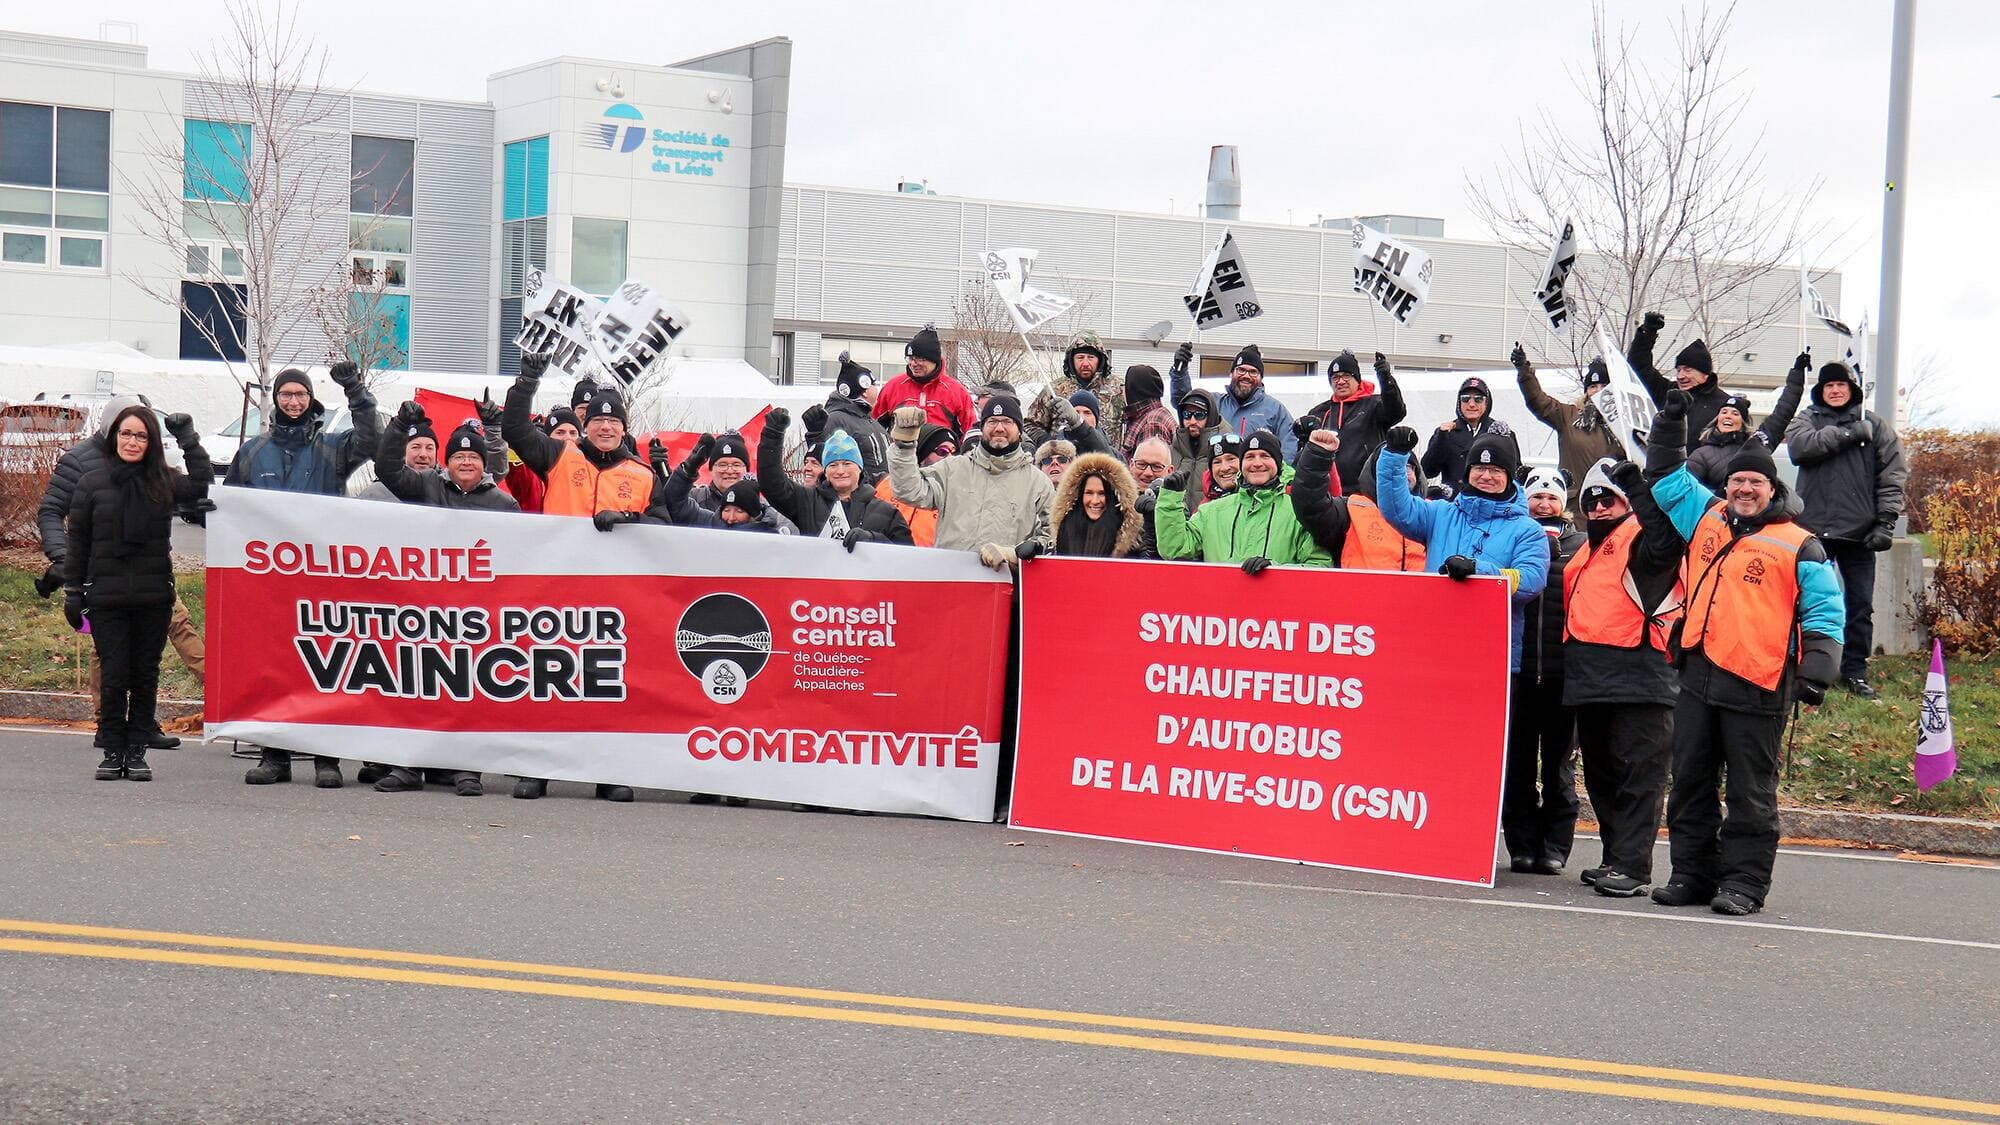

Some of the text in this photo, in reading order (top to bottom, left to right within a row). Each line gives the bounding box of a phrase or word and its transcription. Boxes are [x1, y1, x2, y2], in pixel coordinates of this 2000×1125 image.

[652, 128, 730, 148] Société de
[652, 145, 724, 162] transport
[652, 160, 713, 176] de Lévis
[1372, 241, 1410, 277] EN
[991, 272, 1011, 280] CSN
[1213, 259, 1246, 292] EN
[526, 289, 538, 299] SN
[544, 289, 585, 329] EN
[611, 308, 689, 386] RÈVE
[244, 539, 493, 581] SOLIDARITÉ
[1743, 575, 1762, 585] CSN
[300, 602, 624, 641] LUTTONS POUR
[790, 600, 897, 625] Conseil
[792, 625, 896, 647] central
[1139, 613, 1376, 657] SYNDICAT DES
[299, 639, 625, 700] VAINCRE
[793, 652, 811, 663] de
[793, 664, 865, 677] Chaudière-
[713, 686, 737, 696] CSN
[793, 678, 865, 691] Appalaches
[1145, 663, 1364, 710] CHAUFFEURS
[687, 727, 979, 769] COMBATIVITÉ
[1157, 714, 1343, 761] D’AUTOBUS
[1071, 757, 1429, 830] DE LA RIVE-SUD (CSN)
